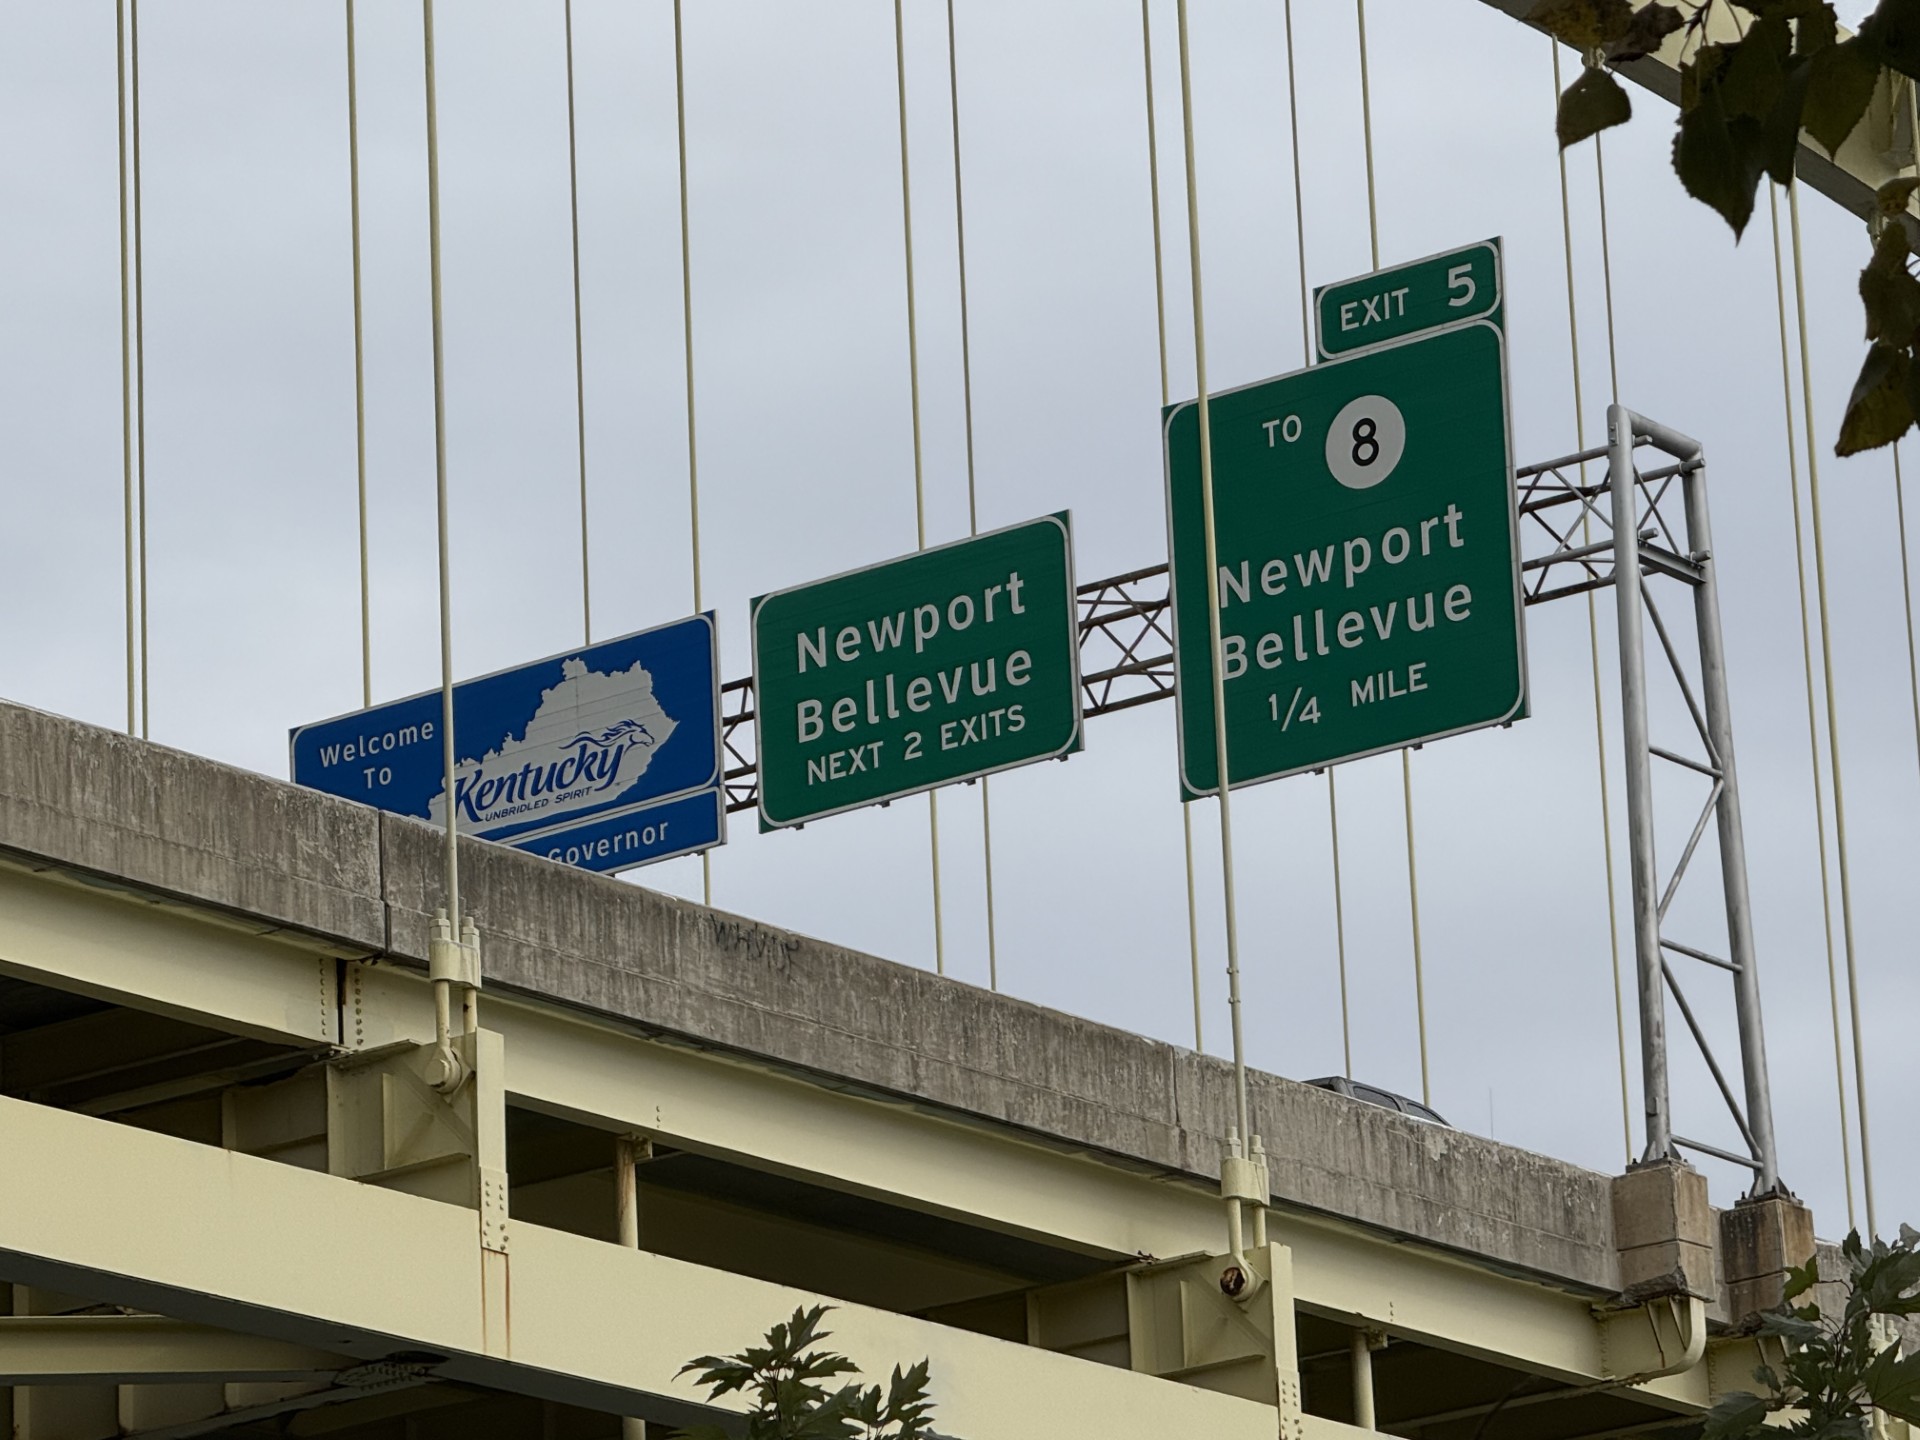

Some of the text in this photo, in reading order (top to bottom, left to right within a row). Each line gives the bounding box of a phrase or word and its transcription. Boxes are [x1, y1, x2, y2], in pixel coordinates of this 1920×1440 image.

[1340, 263, 1476, 331] EXIT 5
[1262, 414, 1380, 467] TO 8
[1218, 503, 1465, 608] Newport
[797, 571, 1026, 674] Newport
[1219, 583, 1472, 681] Bellevue
[797, 650, 1032, 744] Bellevue
[1268, 662, 1429, 732] 1/4 MILE
[319, 720, 434, 768] Welcome
[363, 766, 392, 789] To
[807, 704, 1026, 786] NEXT 2 EXITS
[455, 743, 625, 823] Kentucky
[484, 786, 592, 822] UNBRIDLED SPIRIT
[547, 821, 669, 865] Governor
